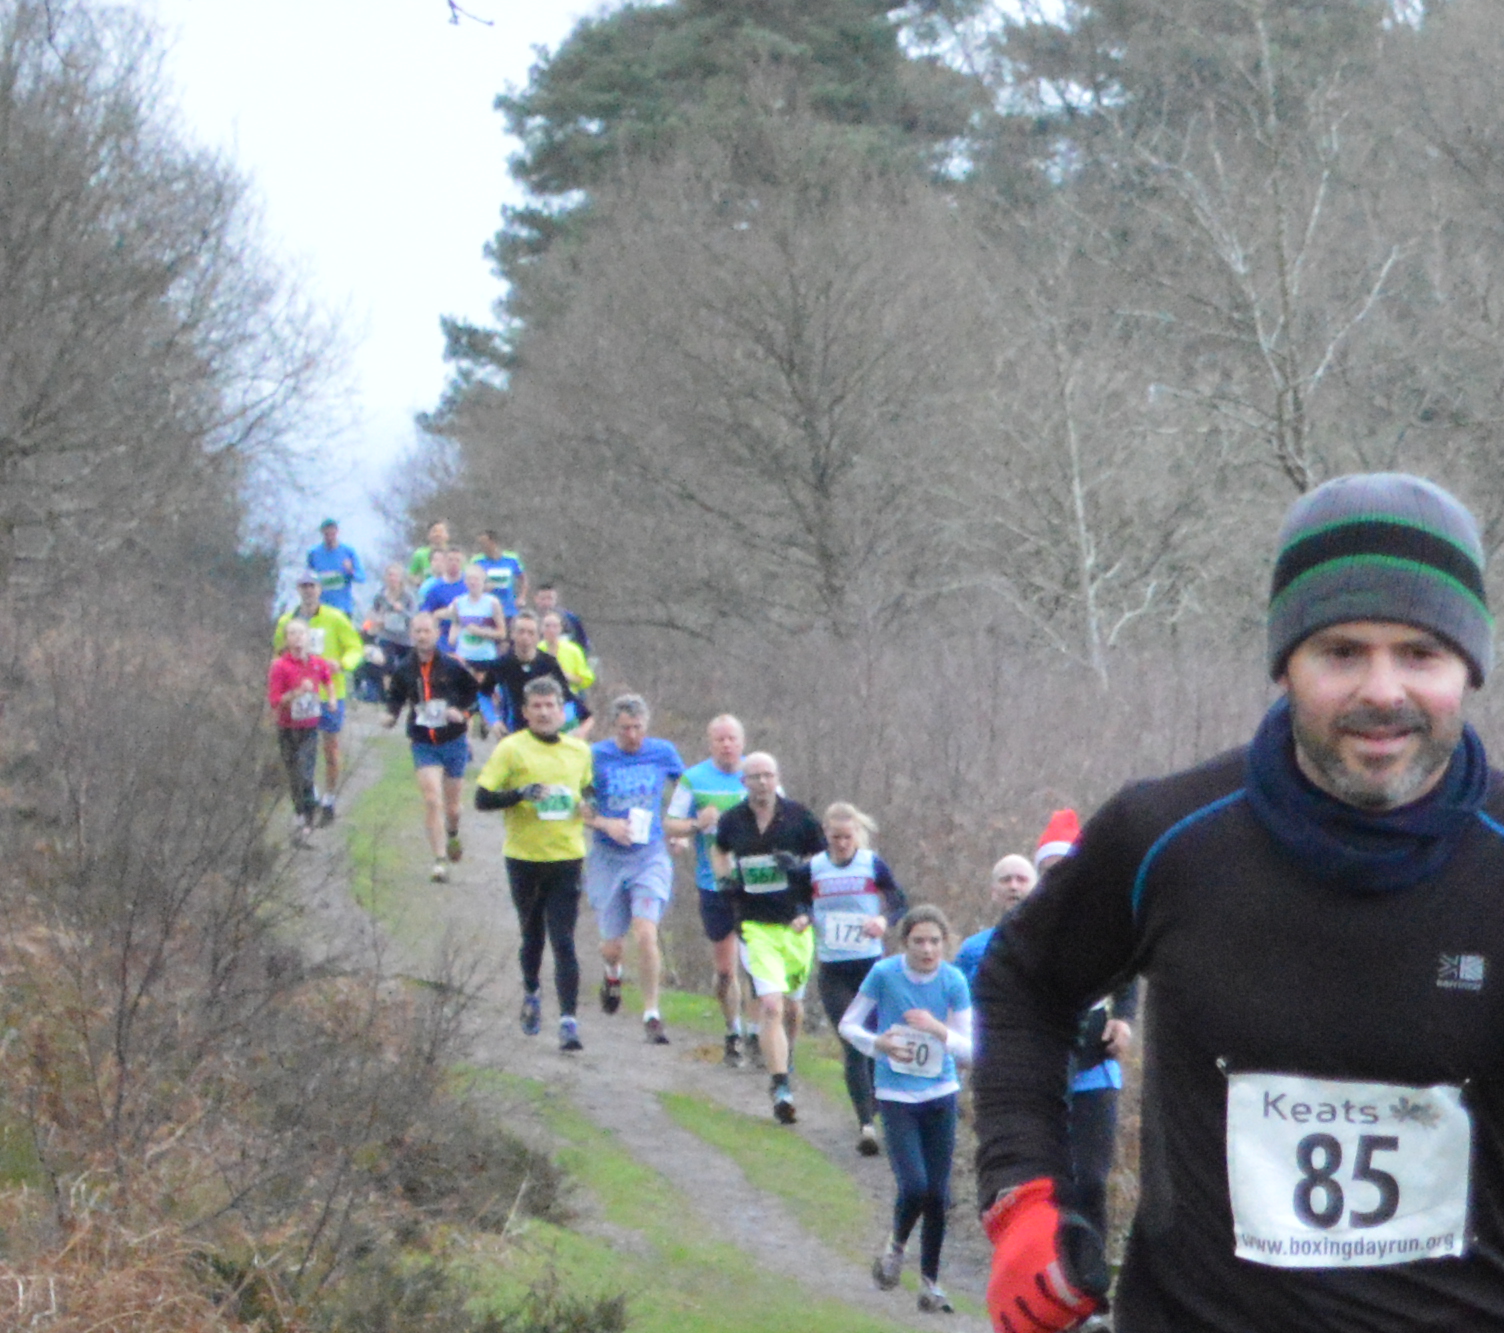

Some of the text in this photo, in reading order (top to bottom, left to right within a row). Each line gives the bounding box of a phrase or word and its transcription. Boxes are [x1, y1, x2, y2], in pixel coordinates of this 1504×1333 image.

[1263, 1091, 1379, 1125] Keats
[1292, 1133, 1400, 1229] 85
[1241, 1232, 1454, 1260] www.boxingdayrun.org
